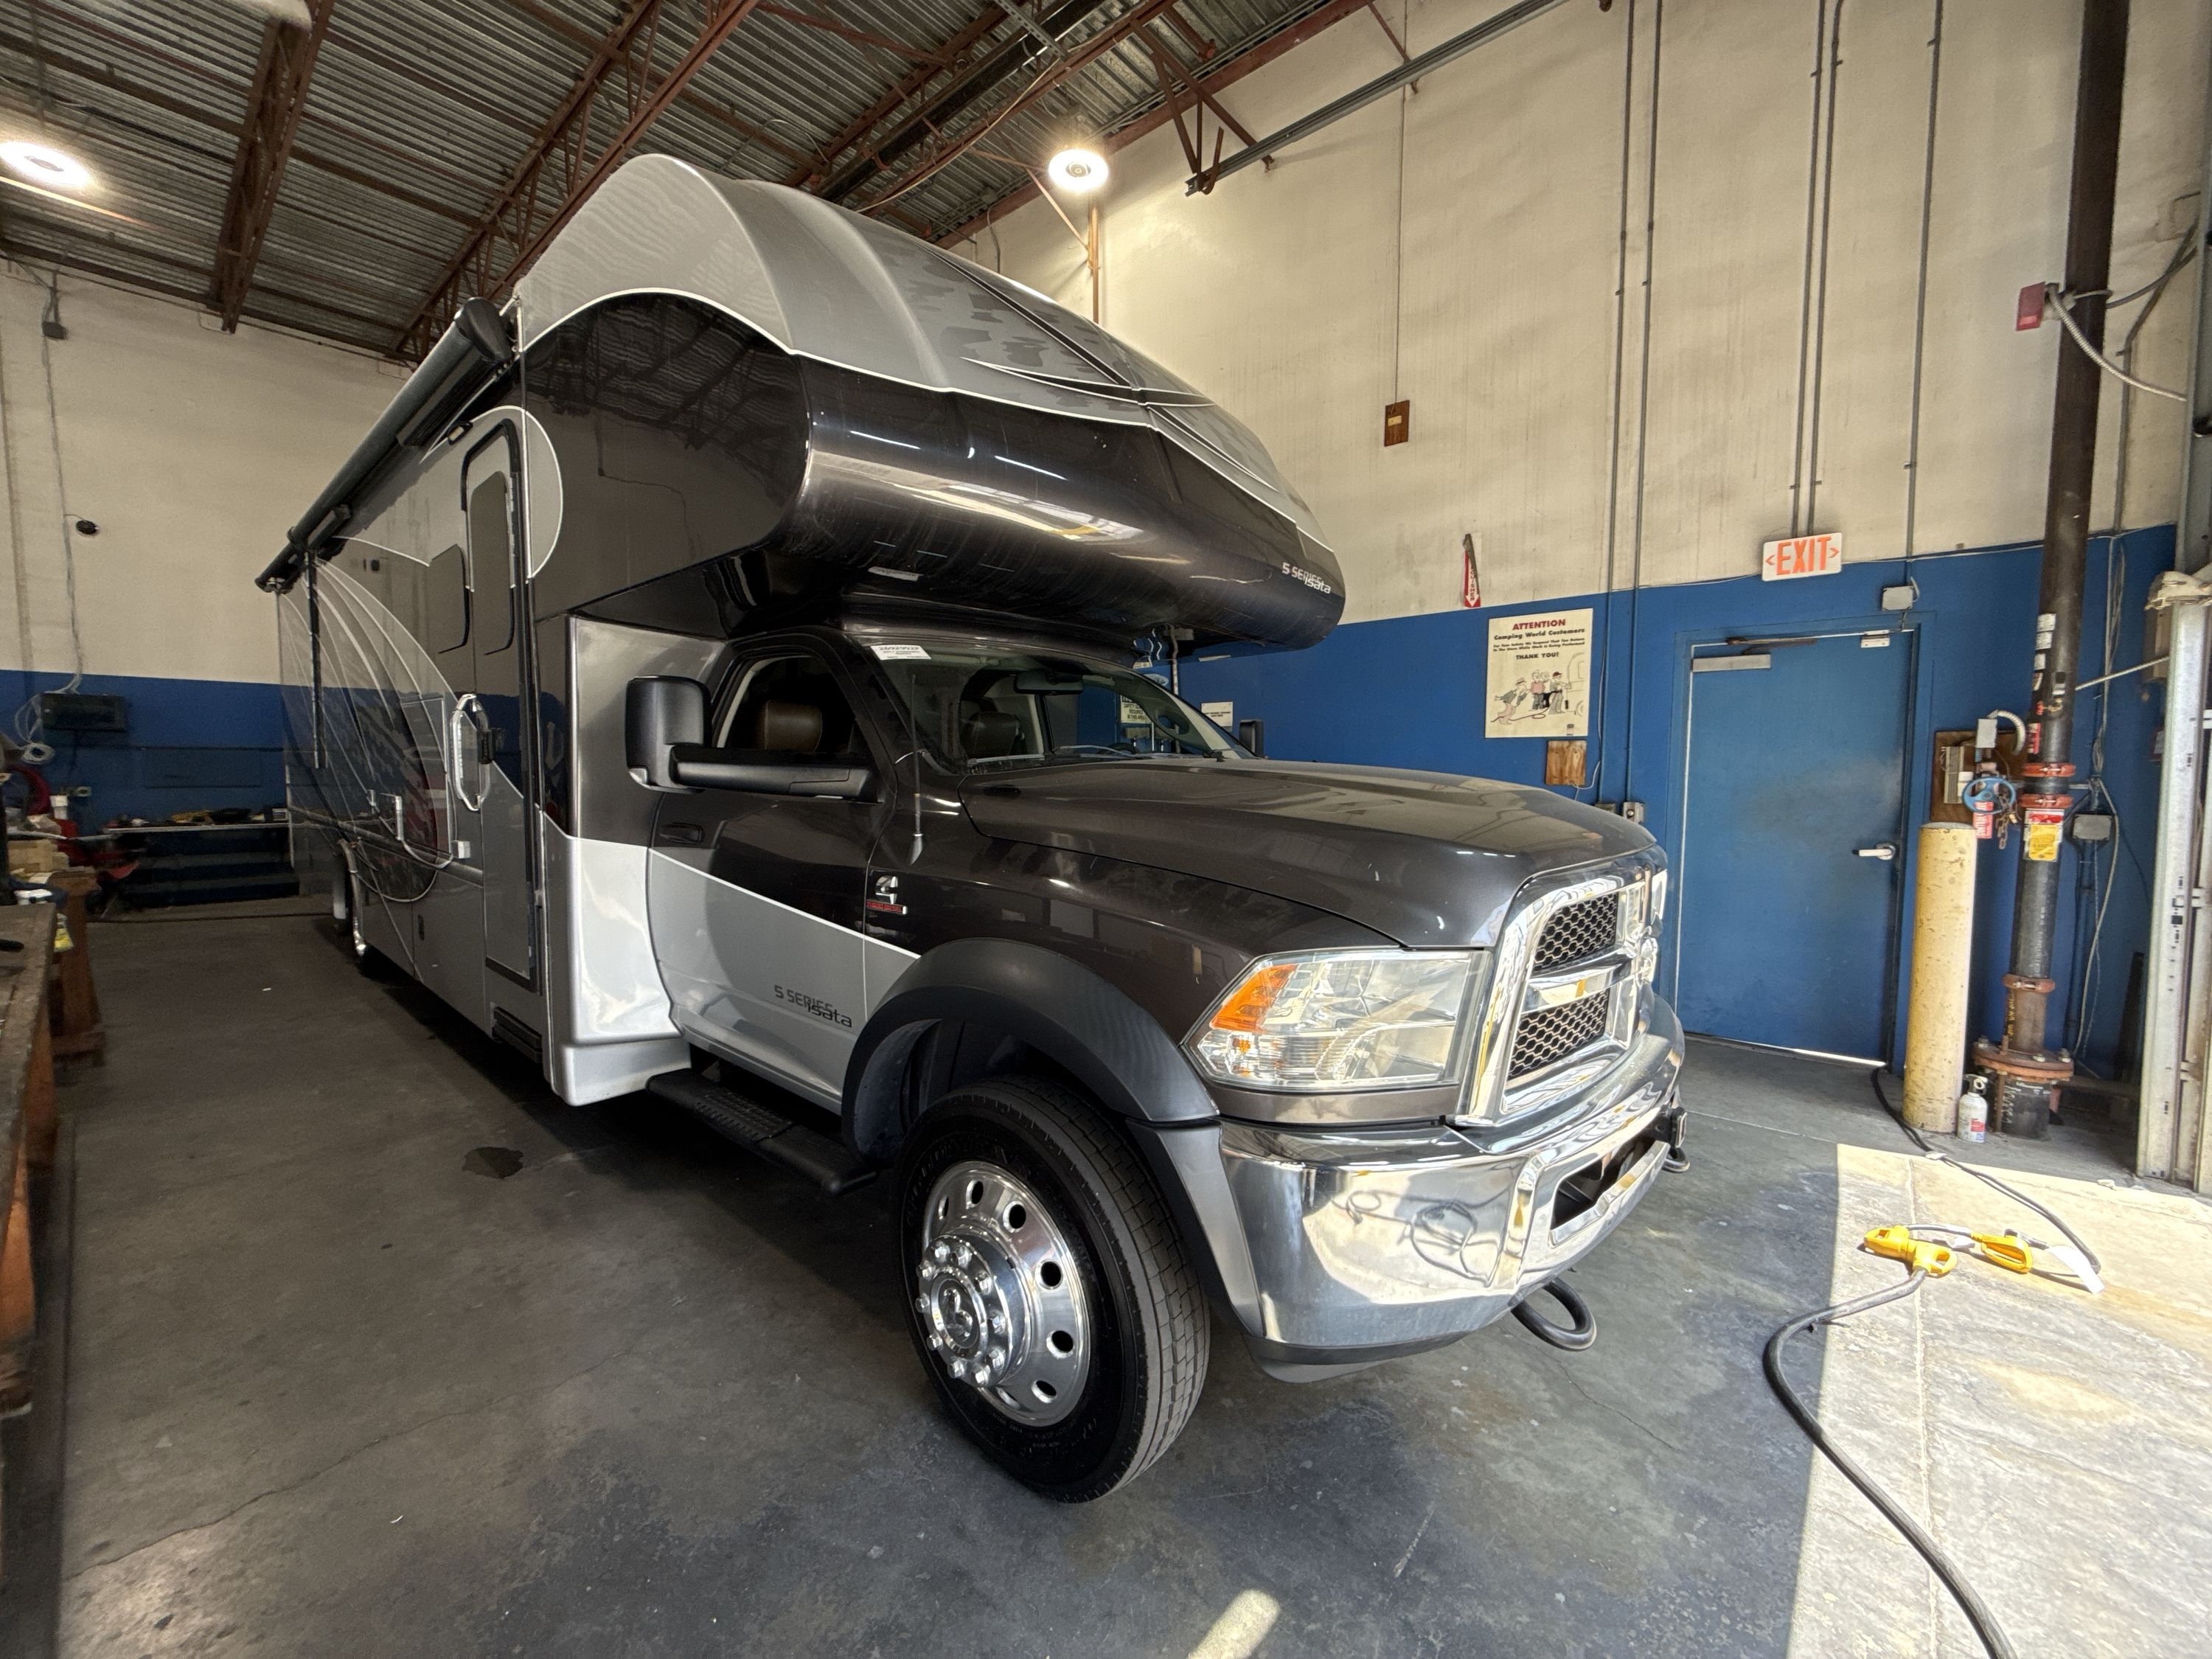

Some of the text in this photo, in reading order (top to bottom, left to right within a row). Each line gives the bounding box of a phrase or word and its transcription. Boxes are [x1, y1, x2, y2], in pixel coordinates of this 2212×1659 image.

[1775, 536, 1832, 576] EXIT
[1281, 562, 1290, 575] 5
[1512, 619, 1565, 630] ATTENTION
[773, 984, 785, 999] 5
